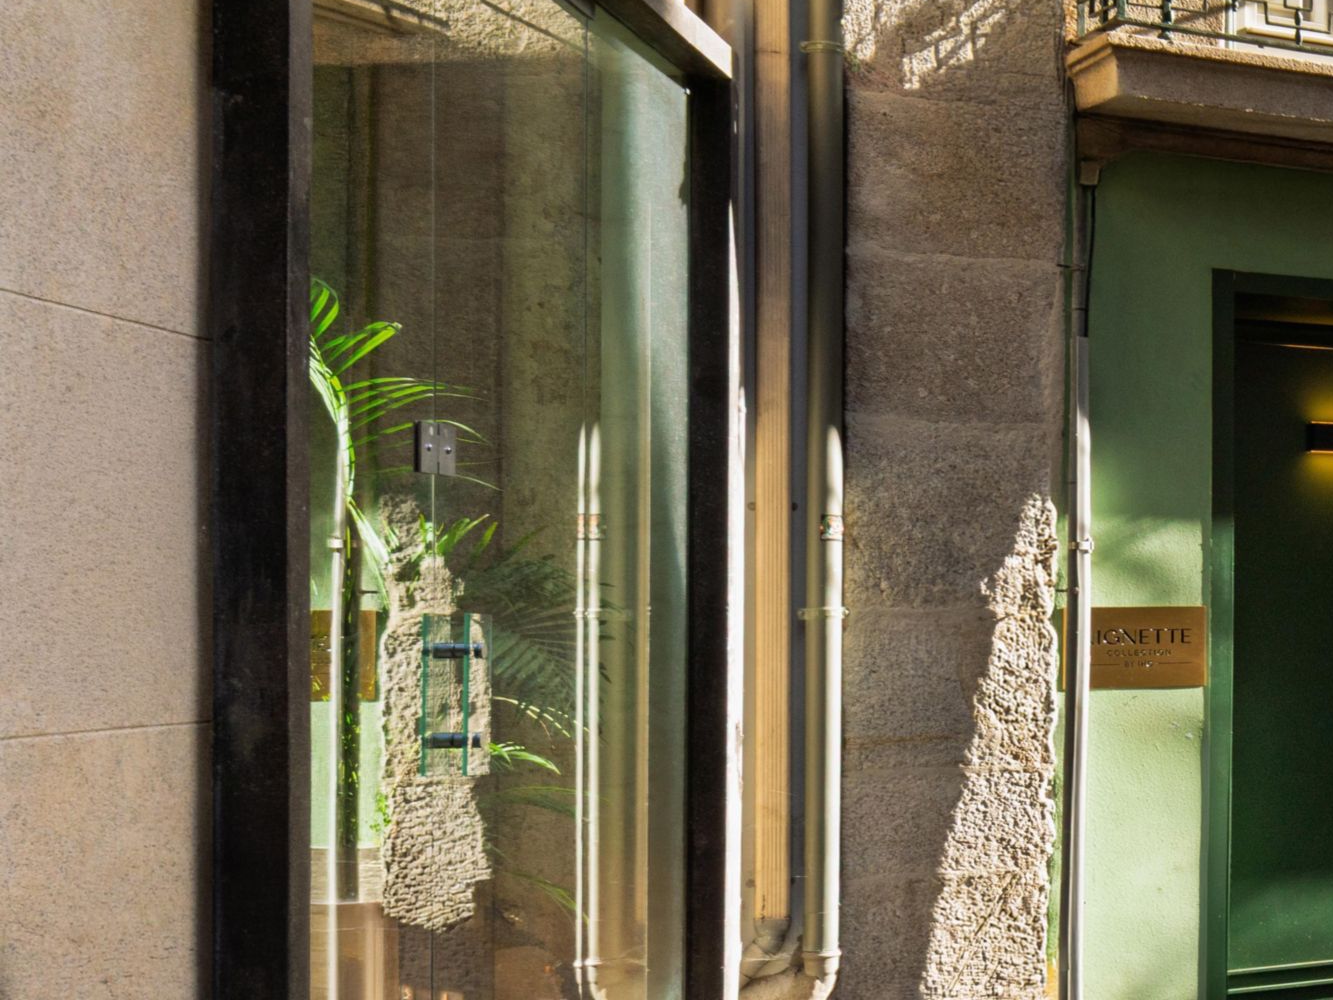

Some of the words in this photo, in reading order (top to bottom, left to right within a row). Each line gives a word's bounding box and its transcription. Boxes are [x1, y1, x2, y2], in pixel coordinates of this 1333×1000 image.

[1091, 628, 1193, 646] IGNETTE
[1106, 648, 1172, 657] COLLECTION
[1124, 660, 1134, 668] BY
